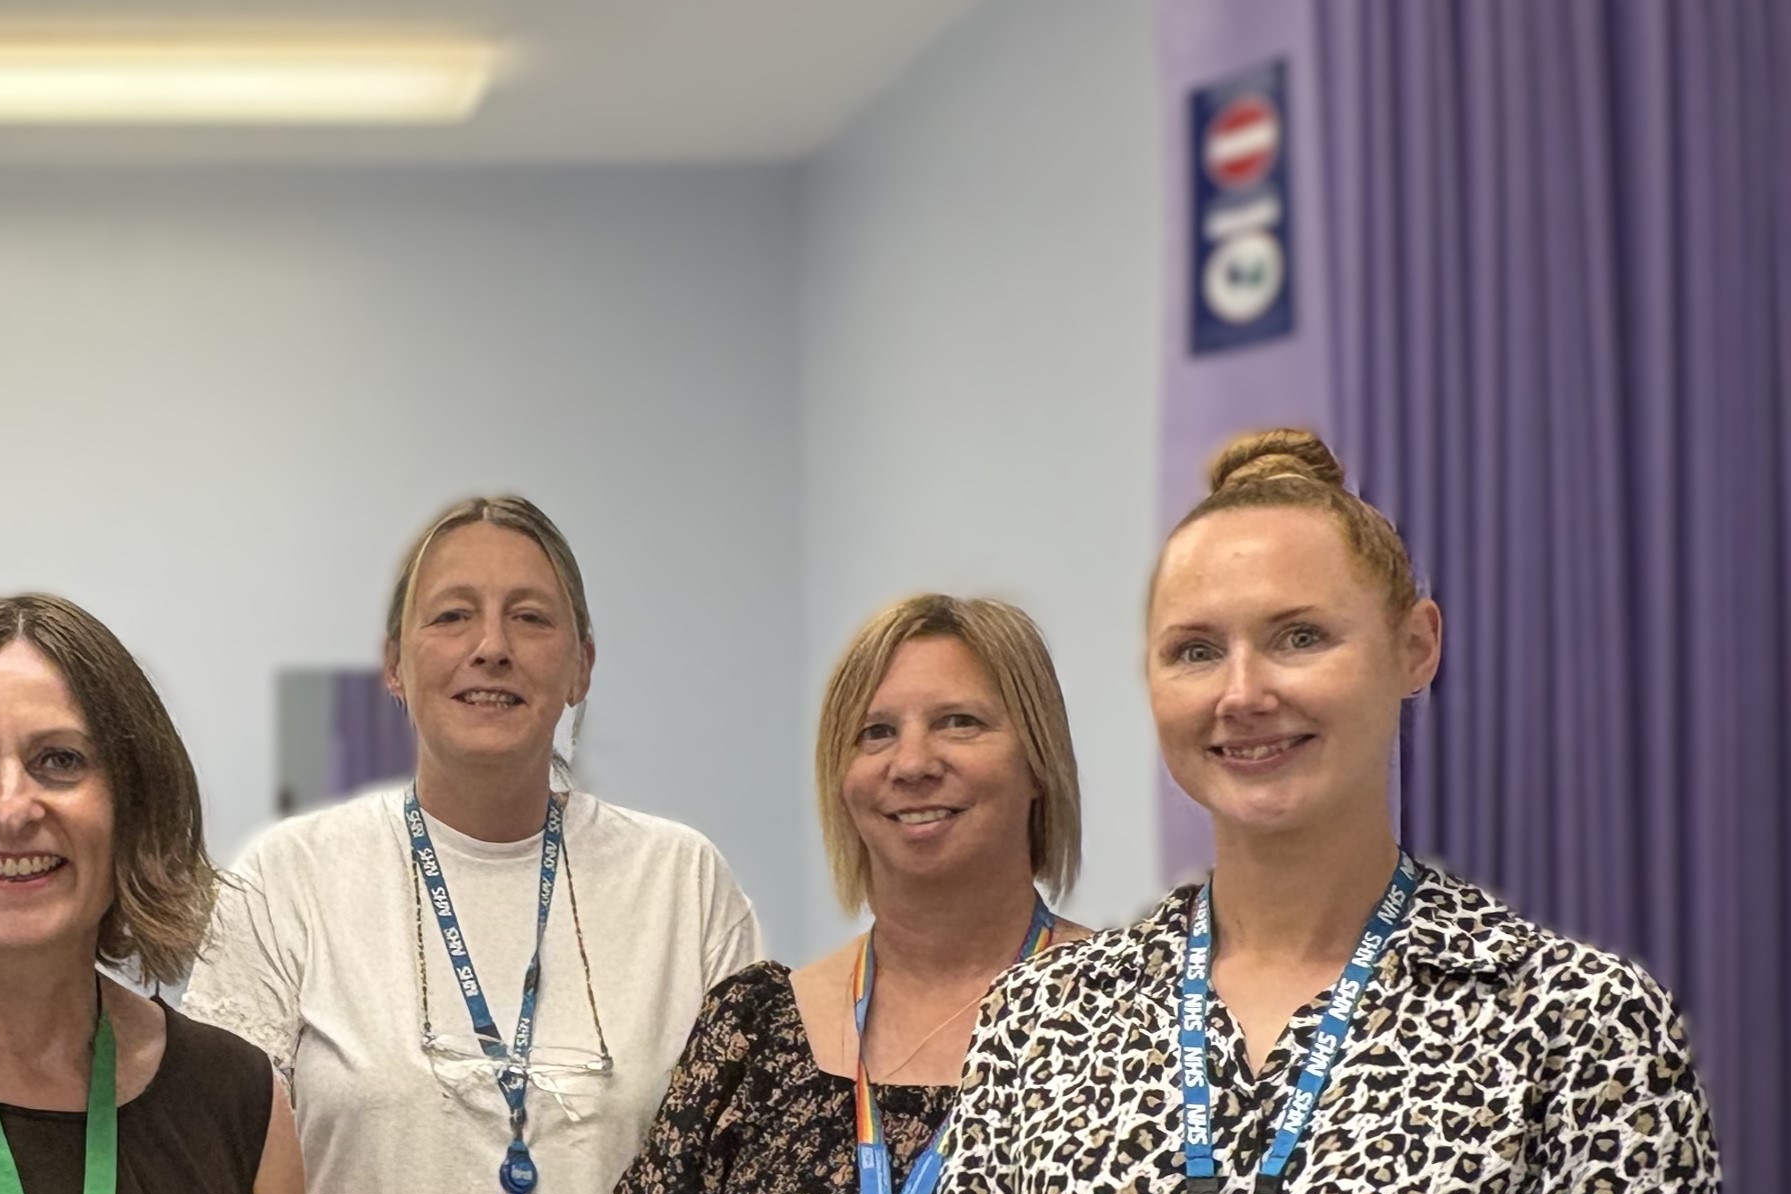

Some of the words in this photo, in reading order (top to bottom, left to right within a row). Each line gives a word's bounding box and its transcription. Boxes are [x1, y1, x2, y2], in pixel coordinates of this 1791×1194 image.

[1186, 946, 1208, 981] NHS
[1183, 993, 1204, 1032] NHS
[1282, 1088, 1314, 1134] NHS
[1305, 1033, 1337, 1078] NHS
[1328, 977, 1361, 1022] NHS
[1351, 930, 1383, 969] NHS
[1376, 884, 1407, 926] NHS
[1183, 1046, 1204, 1088] NHS
[1185, 1103, 1208, 1145] NHS
